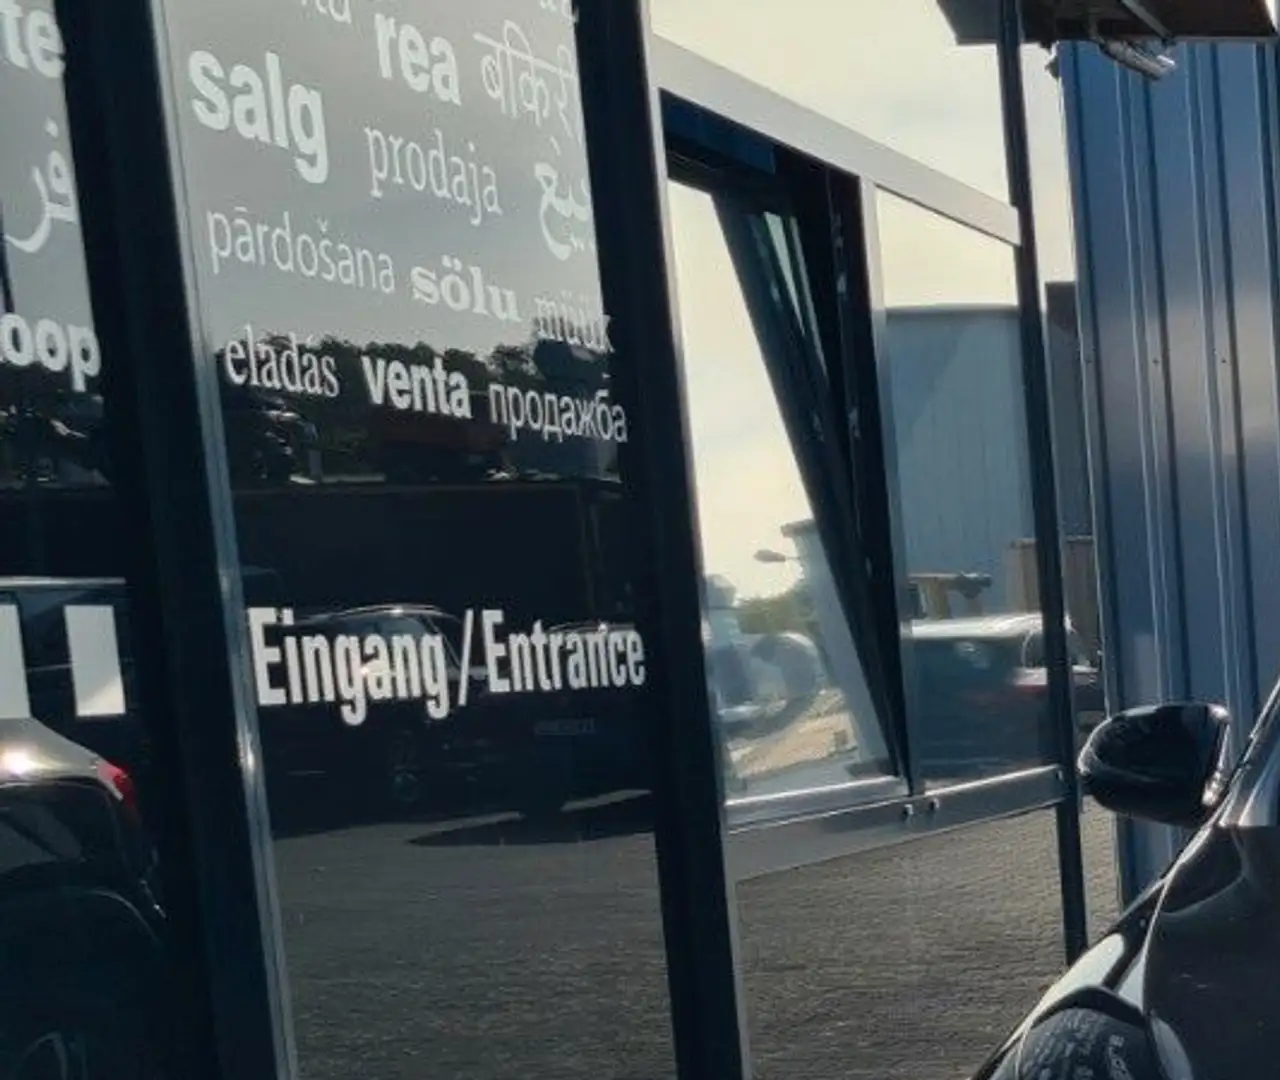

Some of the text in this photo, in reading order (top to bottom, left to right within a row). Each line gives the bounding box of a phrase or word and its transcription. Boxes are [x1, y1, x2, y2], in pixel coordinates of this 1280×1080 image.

[374, 13, 462, 107] rea
[188, 50, 329, 184] salg
[364, 124, 502, 226] prodaja
[207, 207, 396, 293] pārdošana
[410, 257, 522, 323] sölu
[0, 313, 101, 392] oop
[225, 323, 340, 398] eladás
[362, 353, 472, 420] venta
[488, 382, 629, 443] продажба
